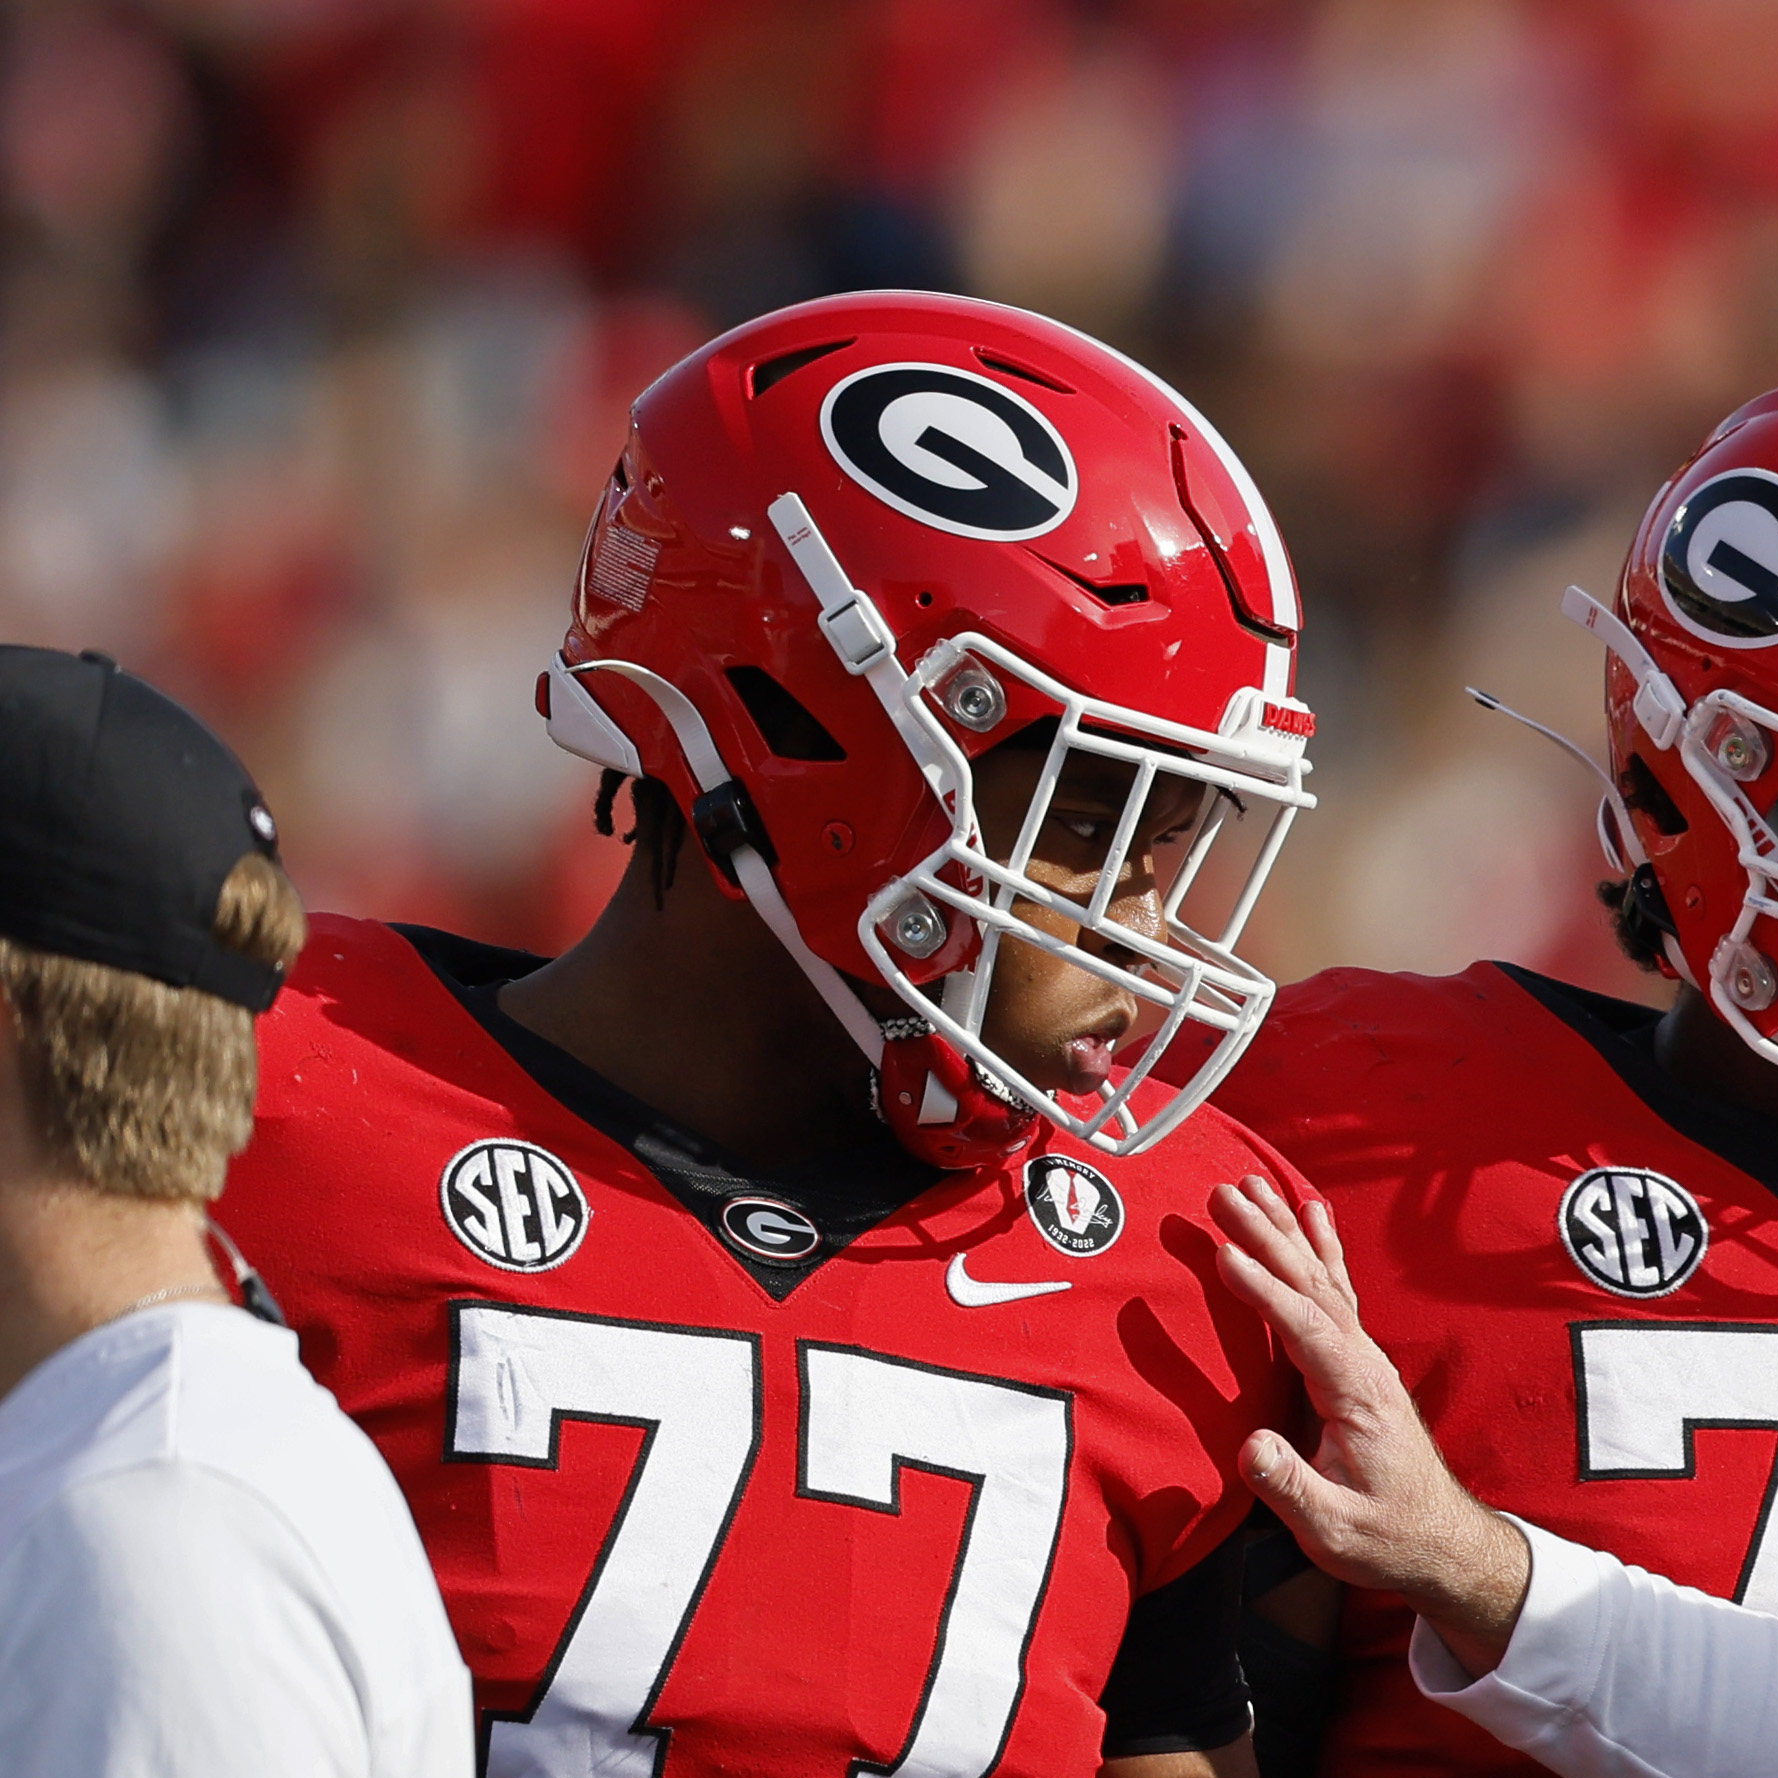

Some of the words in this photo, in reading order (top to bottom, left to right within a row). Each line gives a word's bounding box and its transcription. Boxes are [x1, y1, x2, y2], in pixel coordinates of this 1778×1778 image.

[828, 366, 1072, 534] G
[450, 1146, 579, 1263] SEC
[724, 1199, 819, 1259] G
[1047, 1223, 1095, 1249] 1932-2022
[1571, 1174, 1697, 1289] SEC
